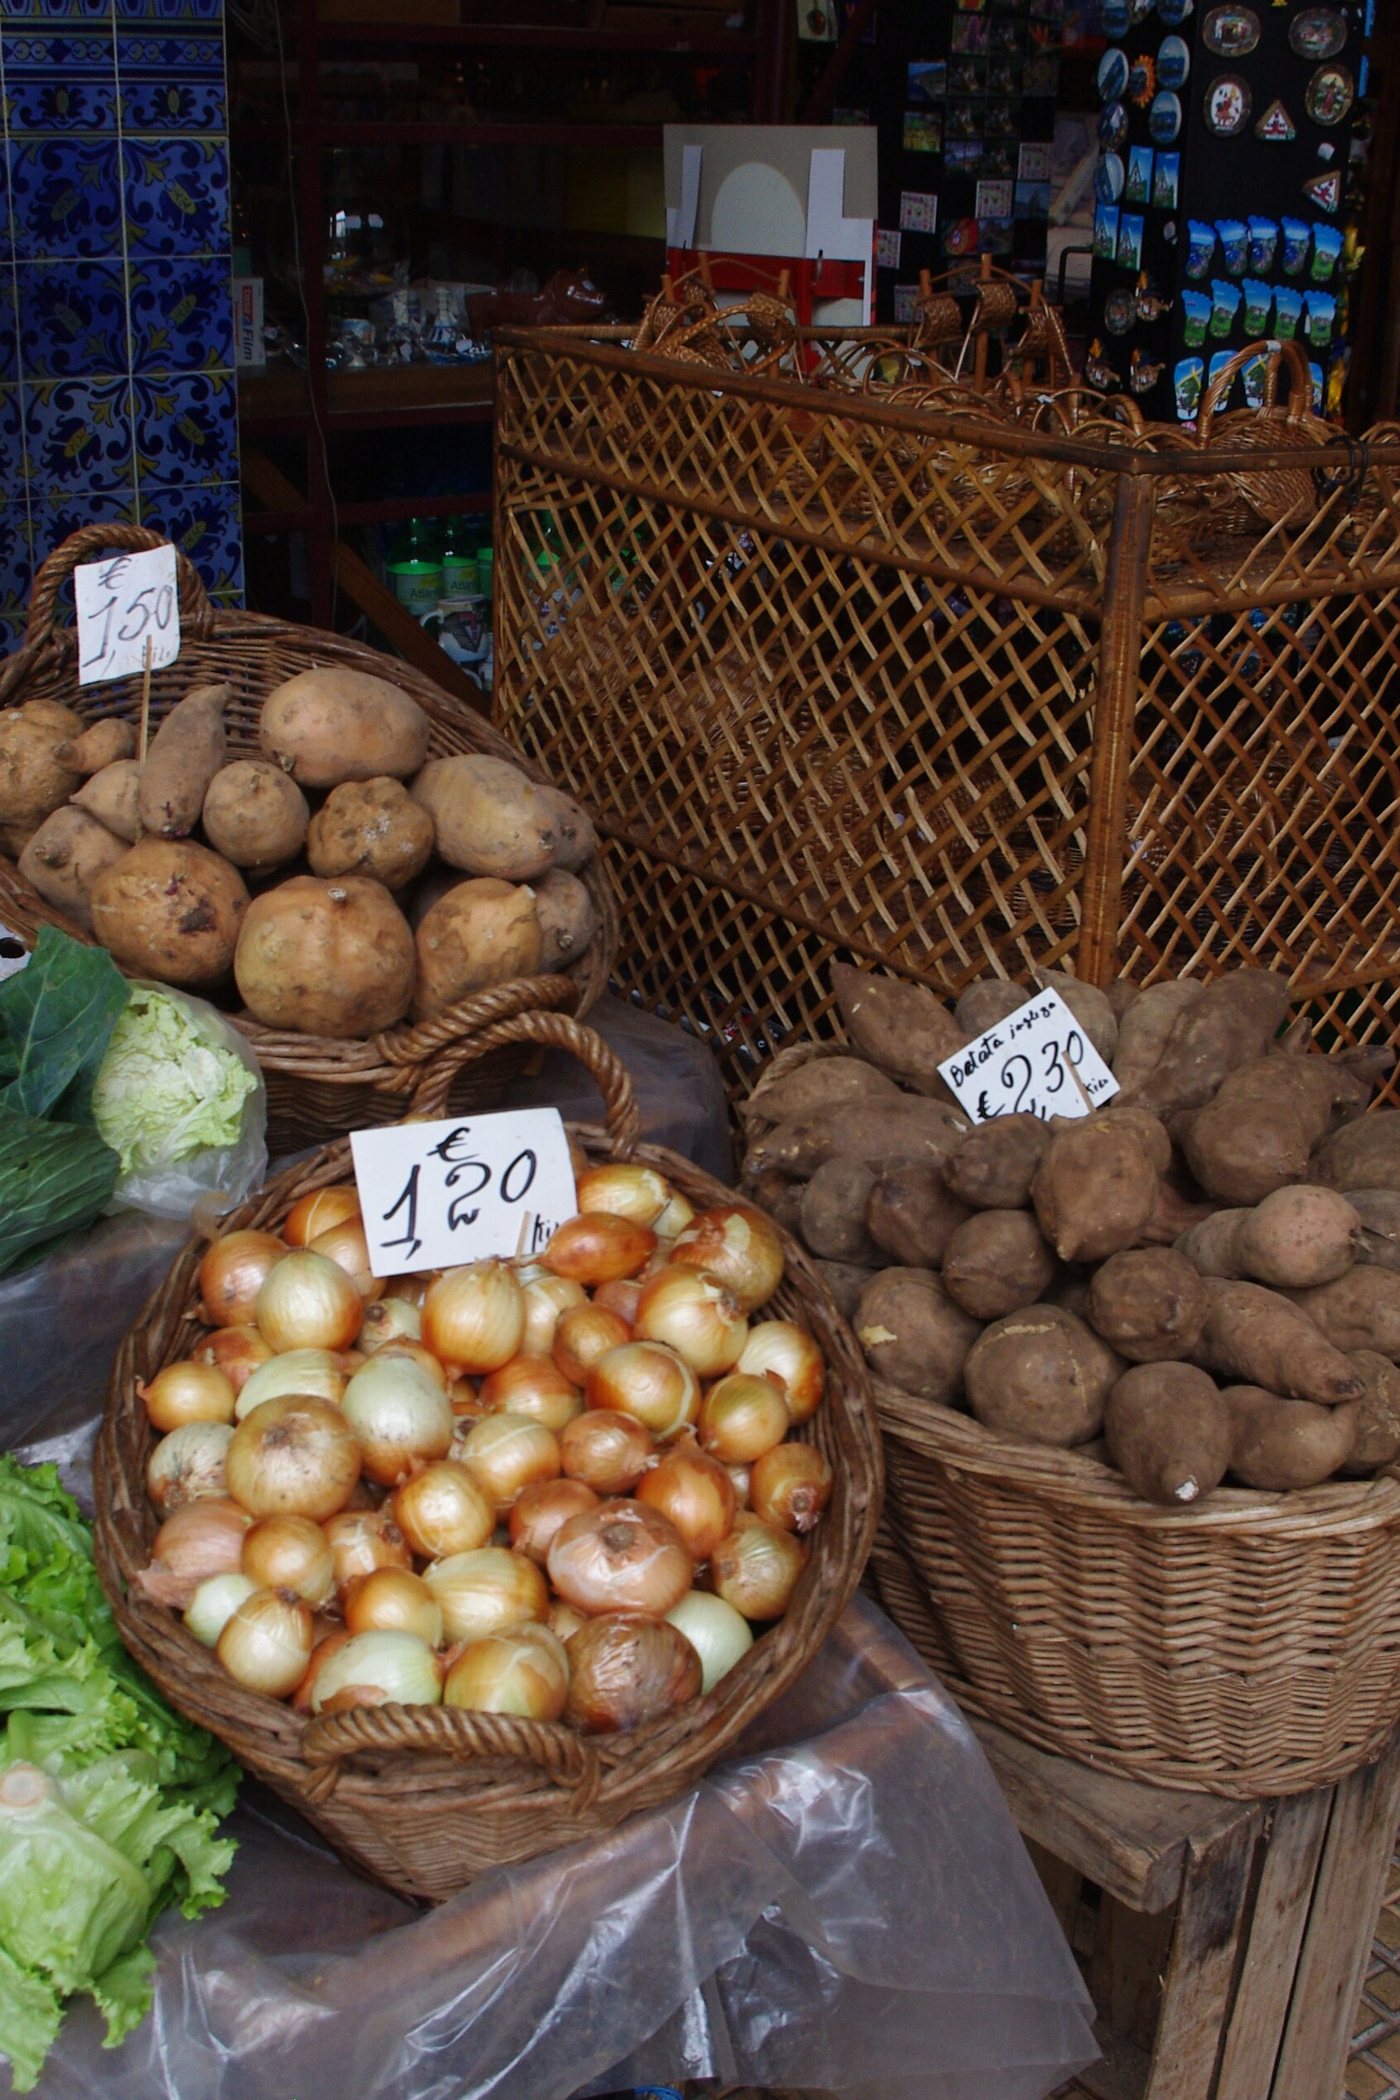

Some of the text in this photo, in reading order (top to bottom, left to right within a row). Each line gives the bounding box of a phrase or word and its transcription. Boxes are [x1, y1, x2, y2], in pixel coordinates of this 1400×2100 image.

[242, 328, 254, 361] Film
[98, 556, 132, 590] €
[976, 1090, 1006, 1119] €
[426, 1126, 480, 1163] €
[380, 1149, 537, 1260] 1,20
